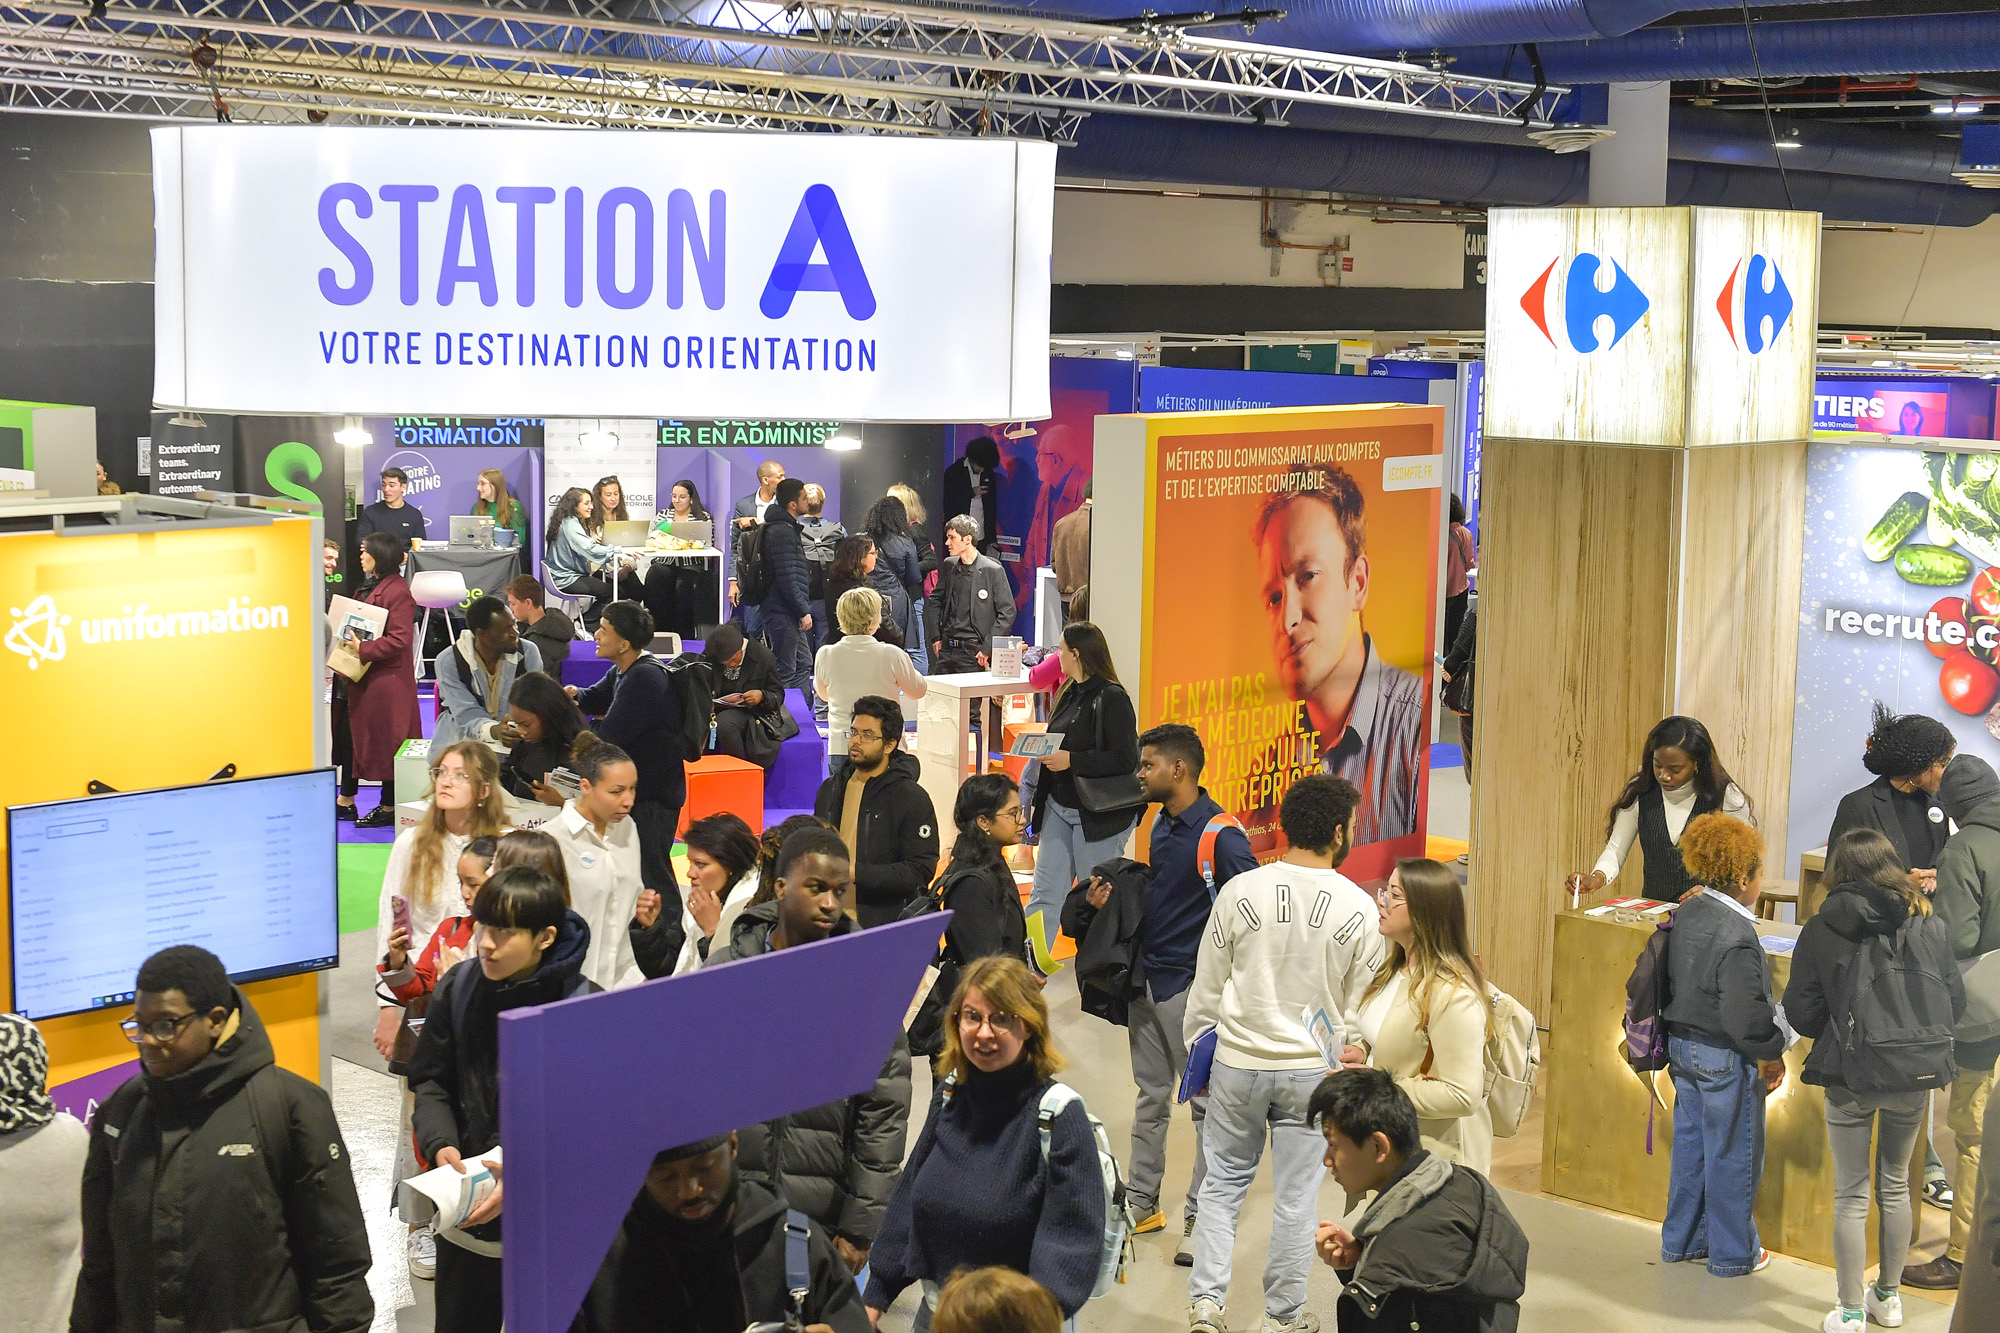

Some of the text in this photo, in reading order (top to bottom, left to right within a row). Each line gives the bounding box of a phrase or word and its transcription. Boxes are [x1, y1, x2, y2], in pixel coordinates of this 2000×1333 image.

[318, 182, 877, 321] STATION A
[319, 331, 876, 371] VOTRE DESTINATION ORIENTATION
[1156, 393, 1196, 411] MÉTIERS
[1198, 398, 1211, 411] DU
[158, 443, 221, 455] Extraordinary
[657, 427, 691, 445] ER
[697, 427, 728, 445] EN
[158, 458, 190, 468] teams.
[1166, 441, 1381, 472] MÉTIERS DU COMMISSARIAT AUX COMPTES
[158, 469, 222, 481] Extraordinary
[402, 474, 441, 497] ATING
[1165, 470, 1326, 500] ET DE L'EXPERTISE COMPTABLE
[1387, 464, 1433, 482] JECOMPTE.FR
[158, 484, 206, 495] outcomes.
[80, 596, 290, 645] uniformation
[1160, 672, 1266, 721] JE N'AI PAS
[1207, 699, 1305, 749] MÉDECINE
[1213, 731, 1321, 783] J'AUSCULTE
